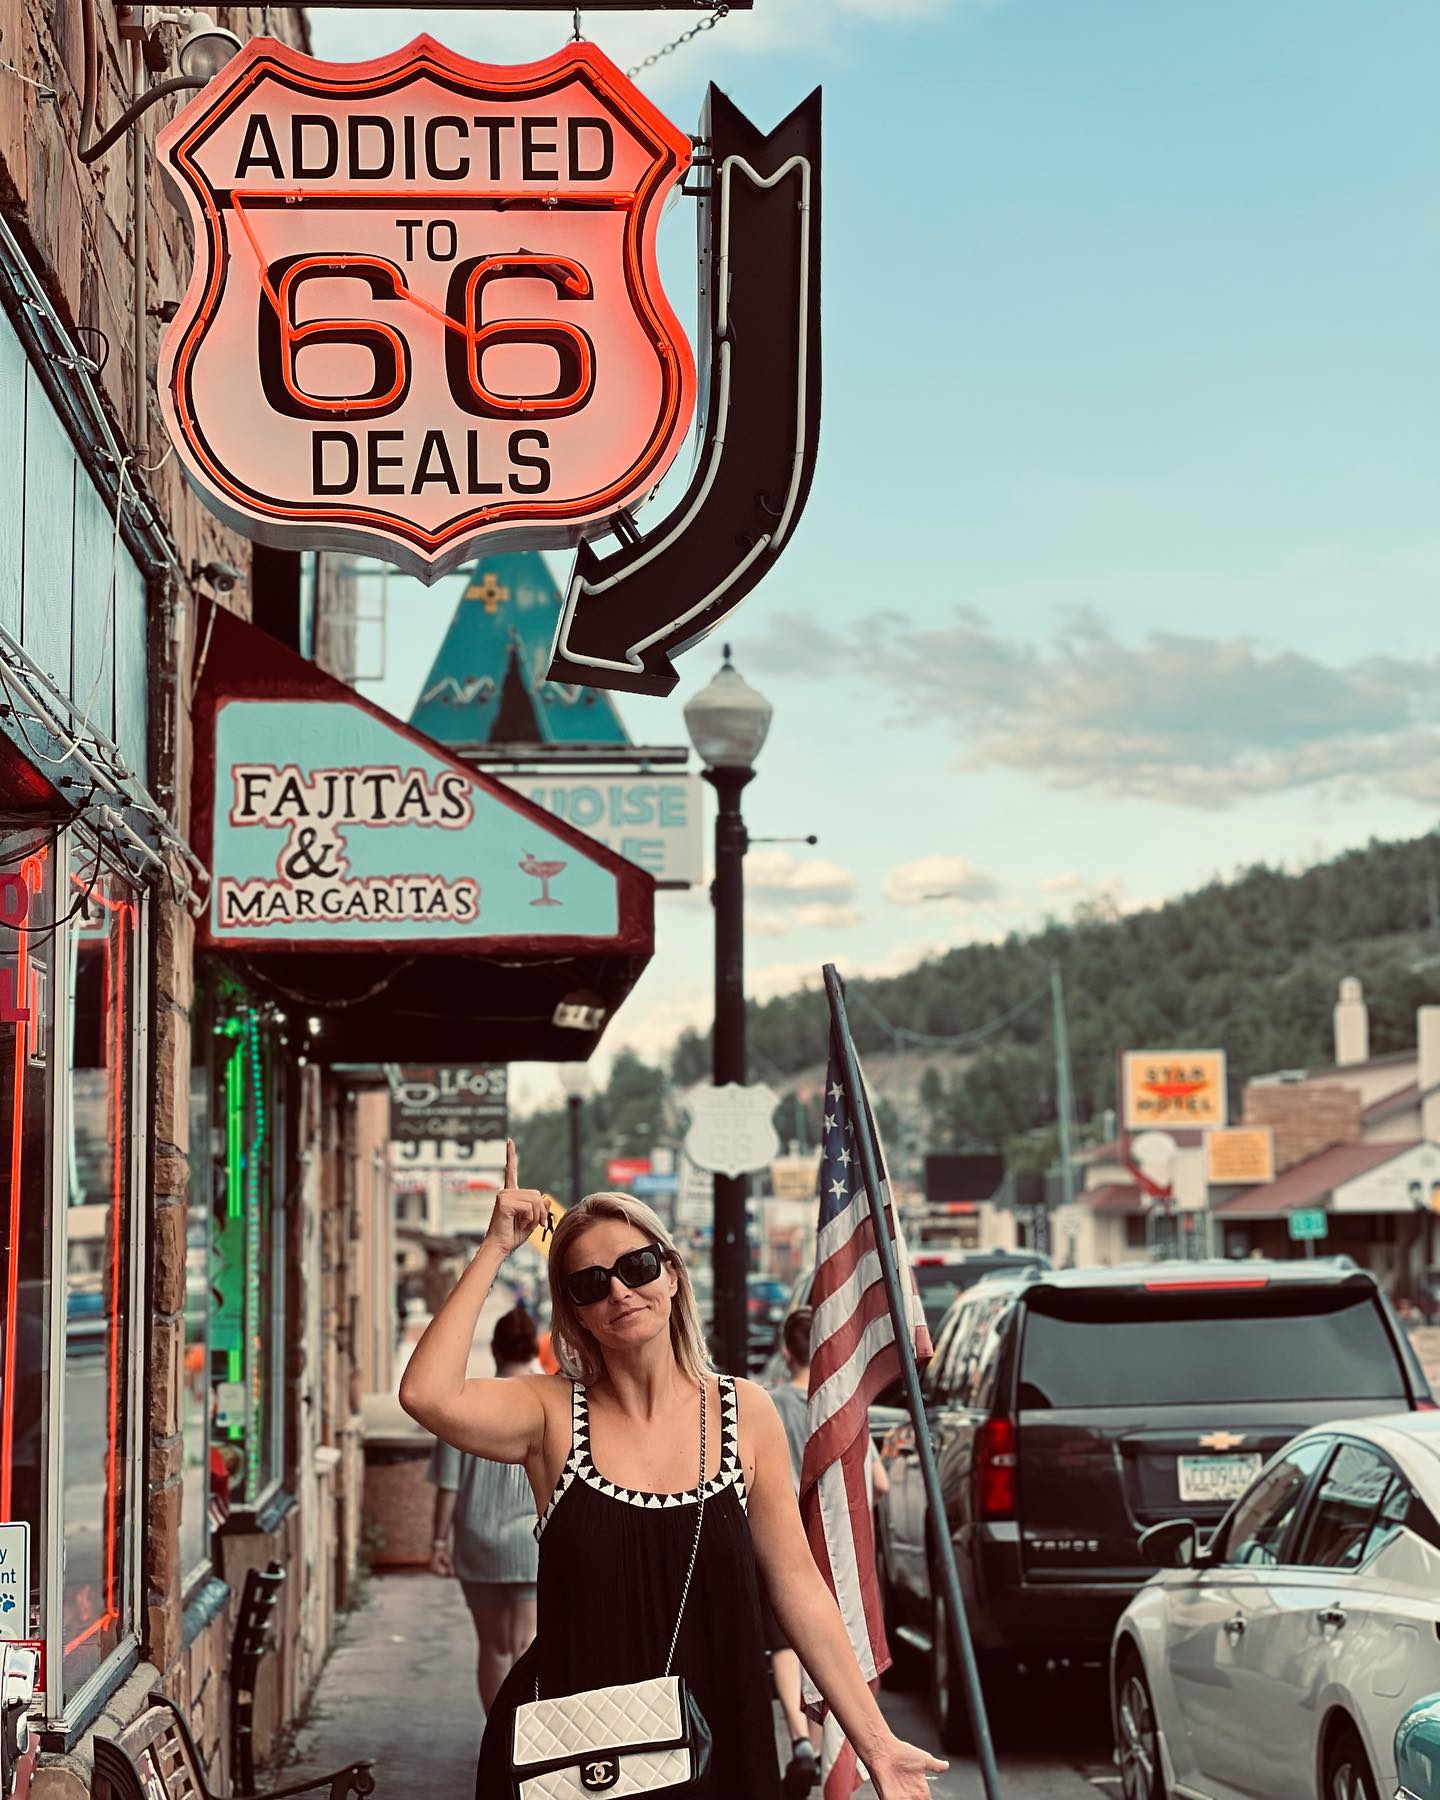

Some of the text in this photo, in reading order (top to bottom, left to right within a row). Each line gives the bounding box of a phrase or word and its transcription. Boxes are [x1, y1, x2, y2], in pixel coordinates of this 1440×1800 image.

[234, 114, 614, 181] ADDICTED
[395, 219, 458, 262] TO
[258, 252, 597, 422] 66
[311, 429, 551, 496] DEALS
[240, 773, 466, 821] FAJITAS
[285, 827, 339, 880] &
[226, 886, 473, 920] MARGARITAS
[1031, 1540, 1099, 1553] TAHOE
